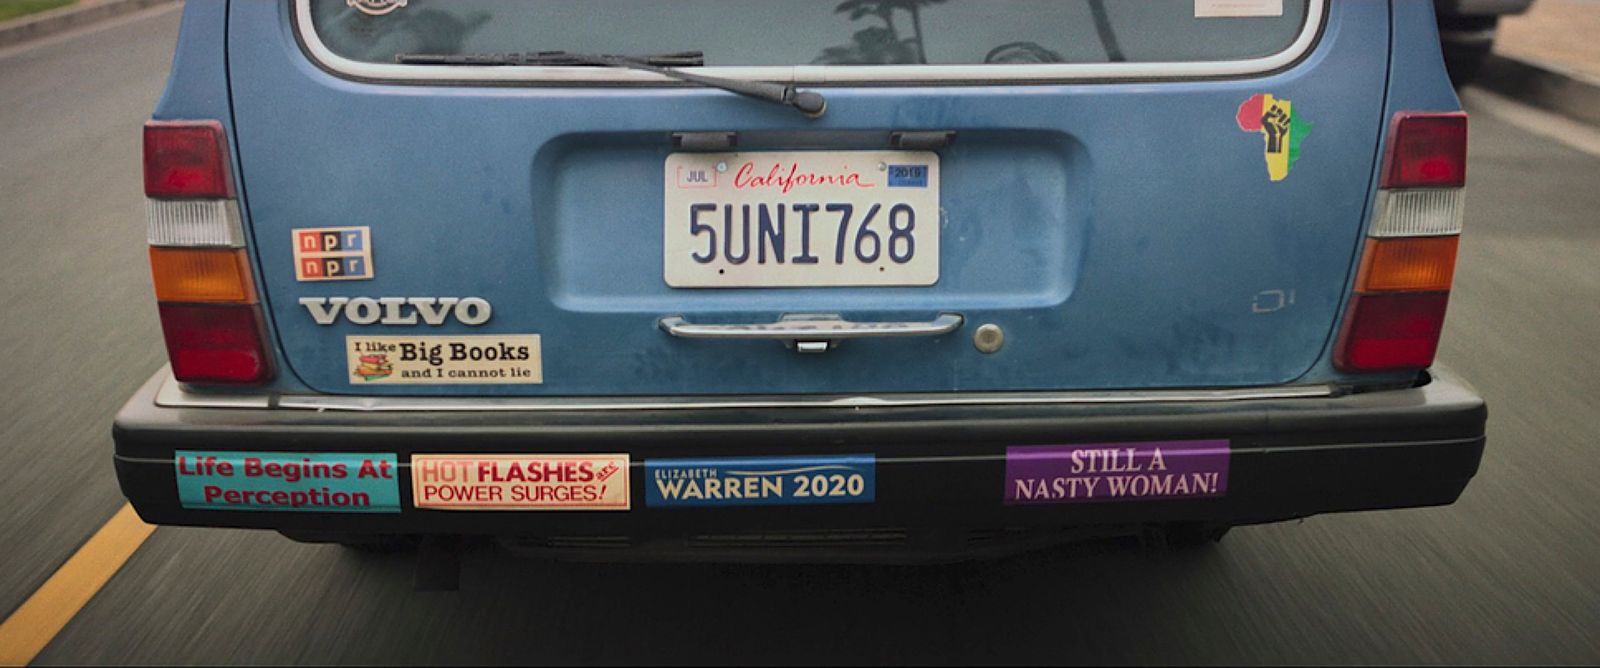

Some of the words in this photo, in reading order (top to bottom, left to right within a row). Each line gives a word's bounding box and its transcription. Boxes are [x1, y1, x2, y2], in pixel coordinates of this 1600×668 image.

[687, 170, 708, 182] JUL
[734, 162, 874, 193] California
[304, 232, 356, 250] npr
[690, 203, 915, 264] 5UNI768
[306, 259, 358, 276] npr
[299, 297, 492, 325] VOLVO
[355, 343, 361, 351] I
[366, 341, 395, 352] like
[400, 342, 443, 365] Big
[450, 342, 529, 361] Books
[401, 369, 431, 378] and
[437, 369, 443, 377] I
[448, 369, 506, 378] cannot
[511, 368, 530, 377] lie
[179, 456, 234, 476] Life
[244, 458, 347, 482] Begins
[358, 459, 392, 479] At
[422, 461, 473, 482] HOT
[477, 461, 594, 482] FLASHES
[1072, 448, 1142, 473] STILL
[1148, 448, 1166, 471] A
[655, 469, 717, 478] ELIZABETH
[204, 486, 370, 507] Perception
[424, 486, 502, 501] POWER
[511, 485, 607, 501] SURGES!
[656, 477, 782, 500] WARREN
[793, 474, 864, 497] 2020
[1015, 477, 1101, 500] NASTY
[1106, 472, 1219, 496] WOMAN!
